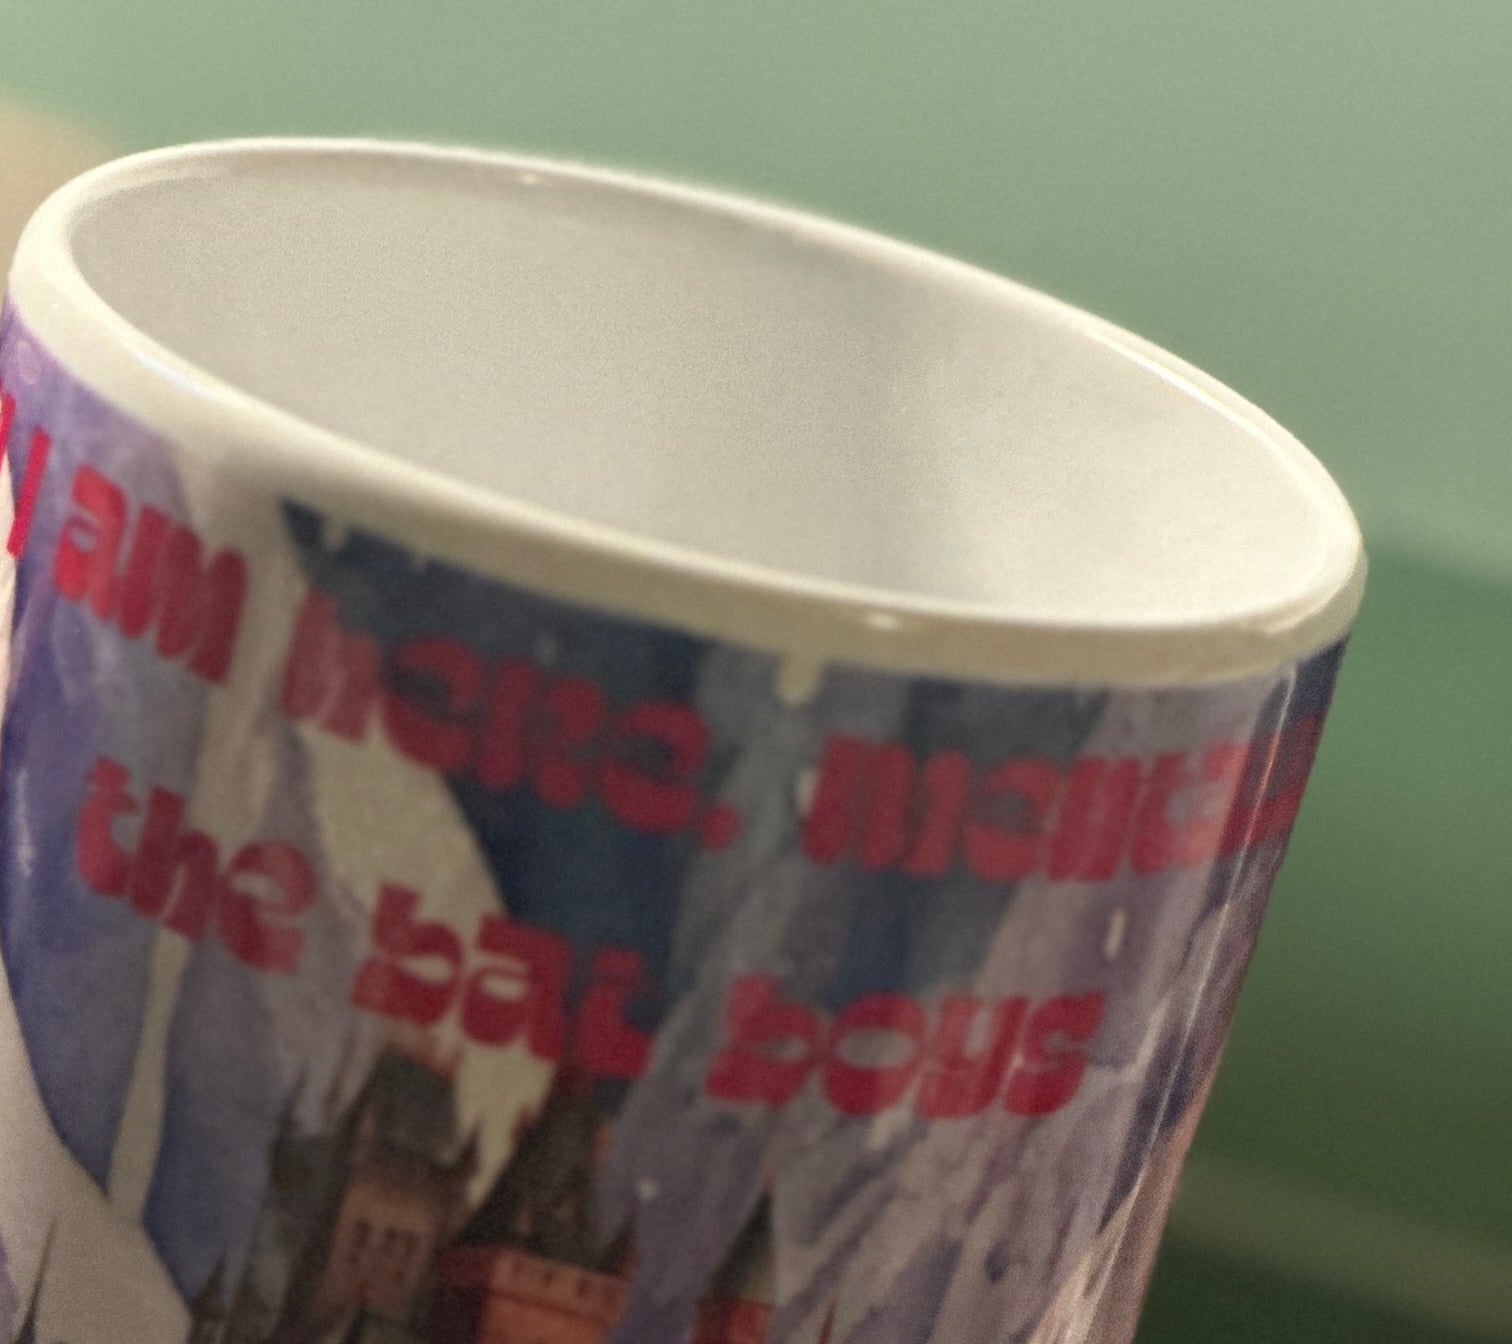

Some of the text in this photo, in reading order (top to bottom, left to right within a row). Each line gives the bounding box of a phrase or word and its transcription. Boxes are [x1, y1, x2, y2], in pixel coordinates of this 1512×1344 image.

[6, 427, 52, 558] I
[53, 466, 246, 684] am
[74, 758, 1106, 1122] the bat boys
